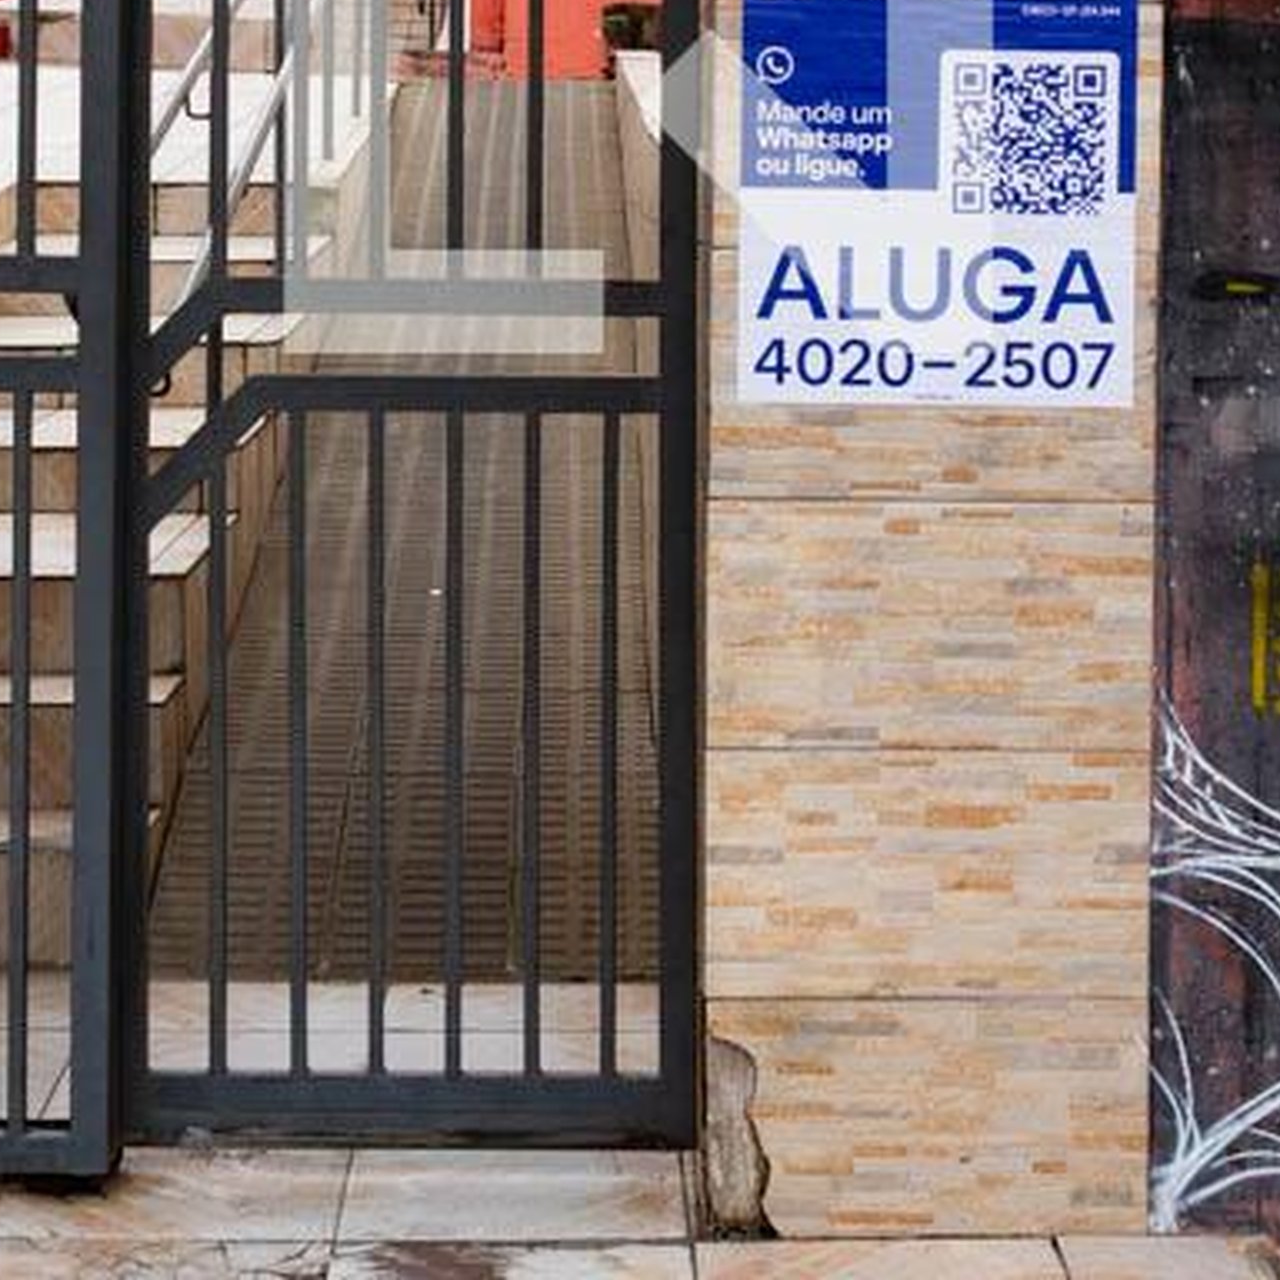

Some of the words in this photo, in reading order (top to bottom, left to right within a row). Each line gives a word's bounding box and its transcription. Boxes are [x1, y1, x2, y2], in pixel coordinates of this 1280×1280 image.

[757, 101, 846, 124] Mande
[851, 105, 892, 124] um
[756, 128, 893, 154] Whatsapp
[756, 159, 789, 176] ou
[795, 155, 867, 180] ligue.
[756, 245, 1113, 323] ALUGA
[754, 339, 1114, 390] 4020-2507
